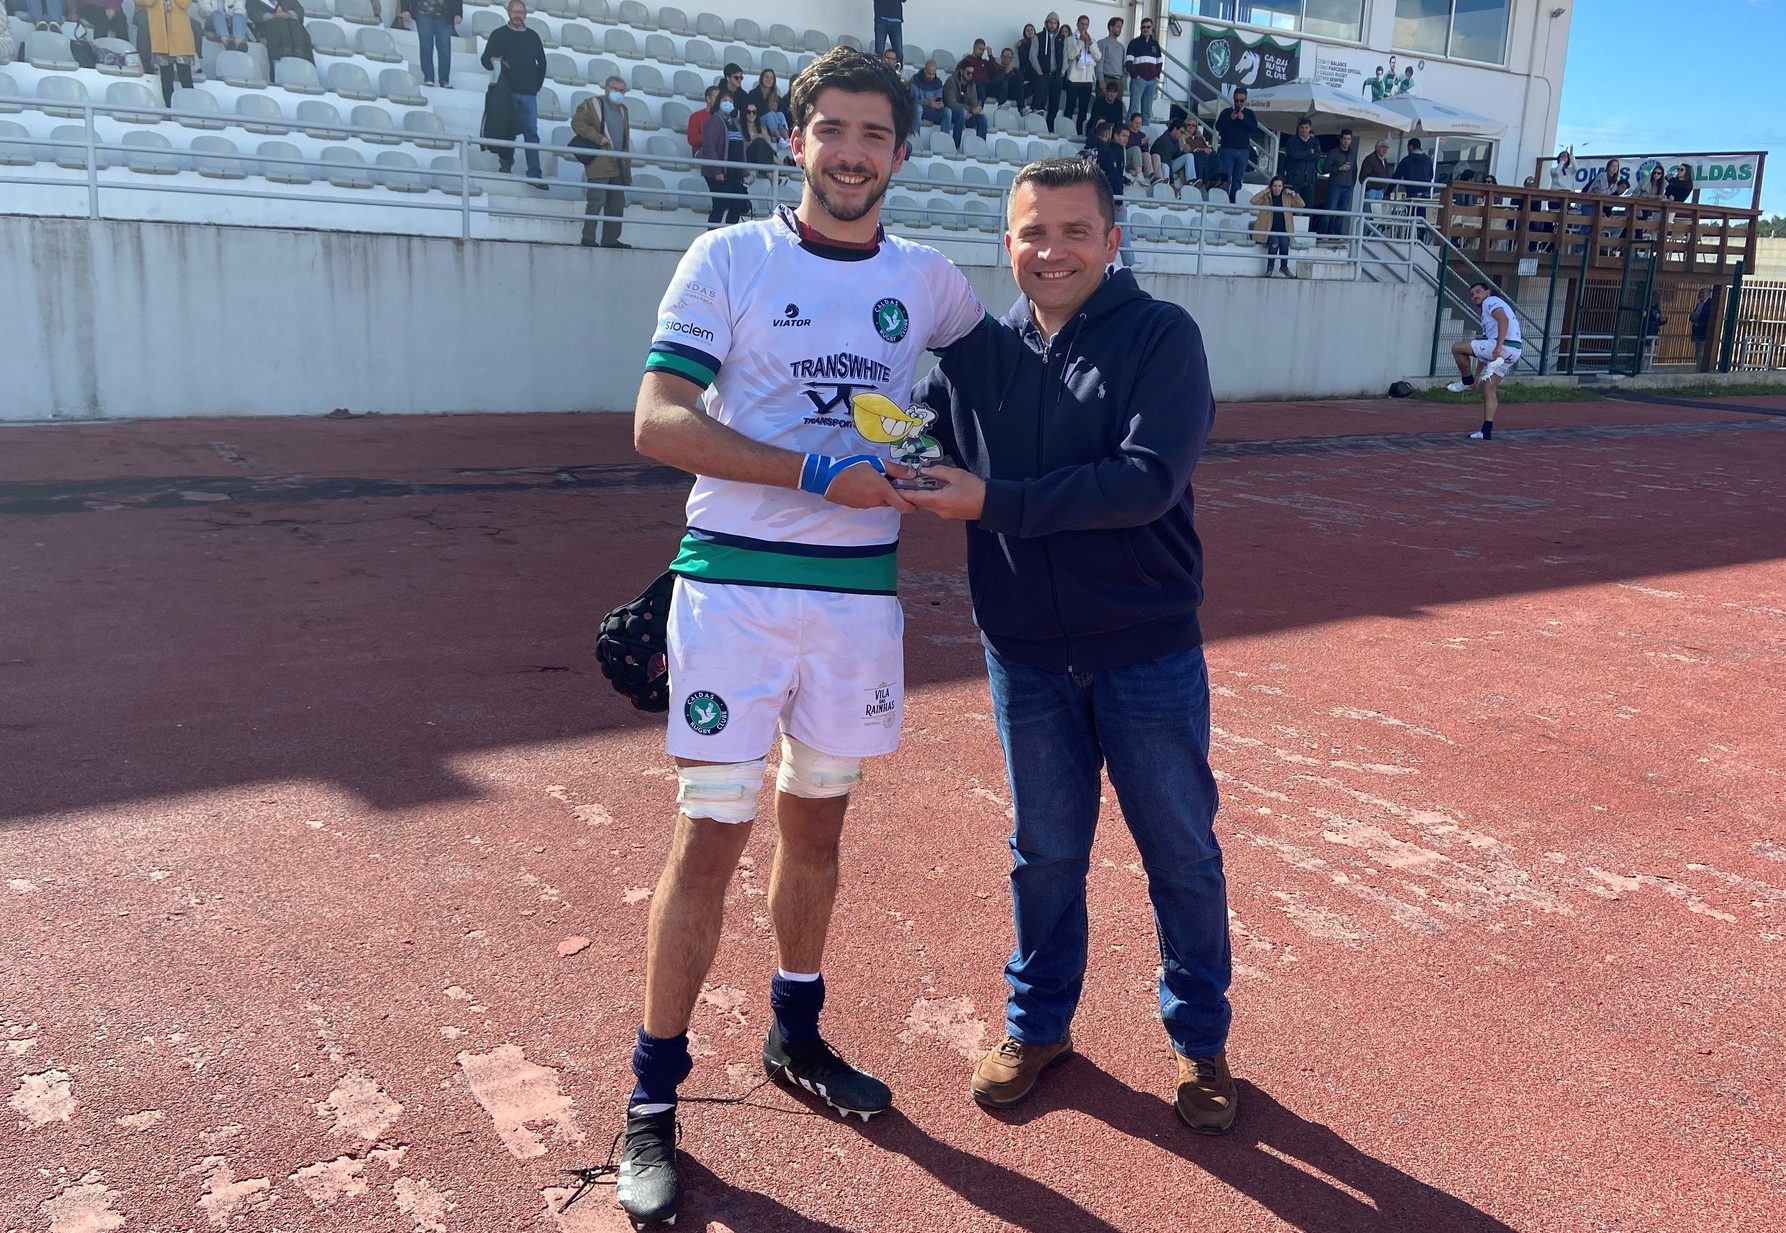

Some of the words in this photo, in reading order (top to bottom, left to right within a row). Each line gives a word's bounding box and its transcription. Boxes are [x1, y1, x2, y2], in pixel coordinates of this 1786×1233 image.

[1265, 54, 1288, 67] CADAS
[875, 300, 898, 313] CALDAS
[773, 319, 811, 327] VIATOR
[665, 321, 714, 342] sioclem
[880, 330, 897, 342] RUGBY
[790, 352, 892, 383] TRANSWHITE
[687, 692, 715, 705] CALDAS
[875, 688, 890, 700] VILA
[866, 700, 894, 716] RAINHAS
[690, 722, 710, 734] RUGBY
